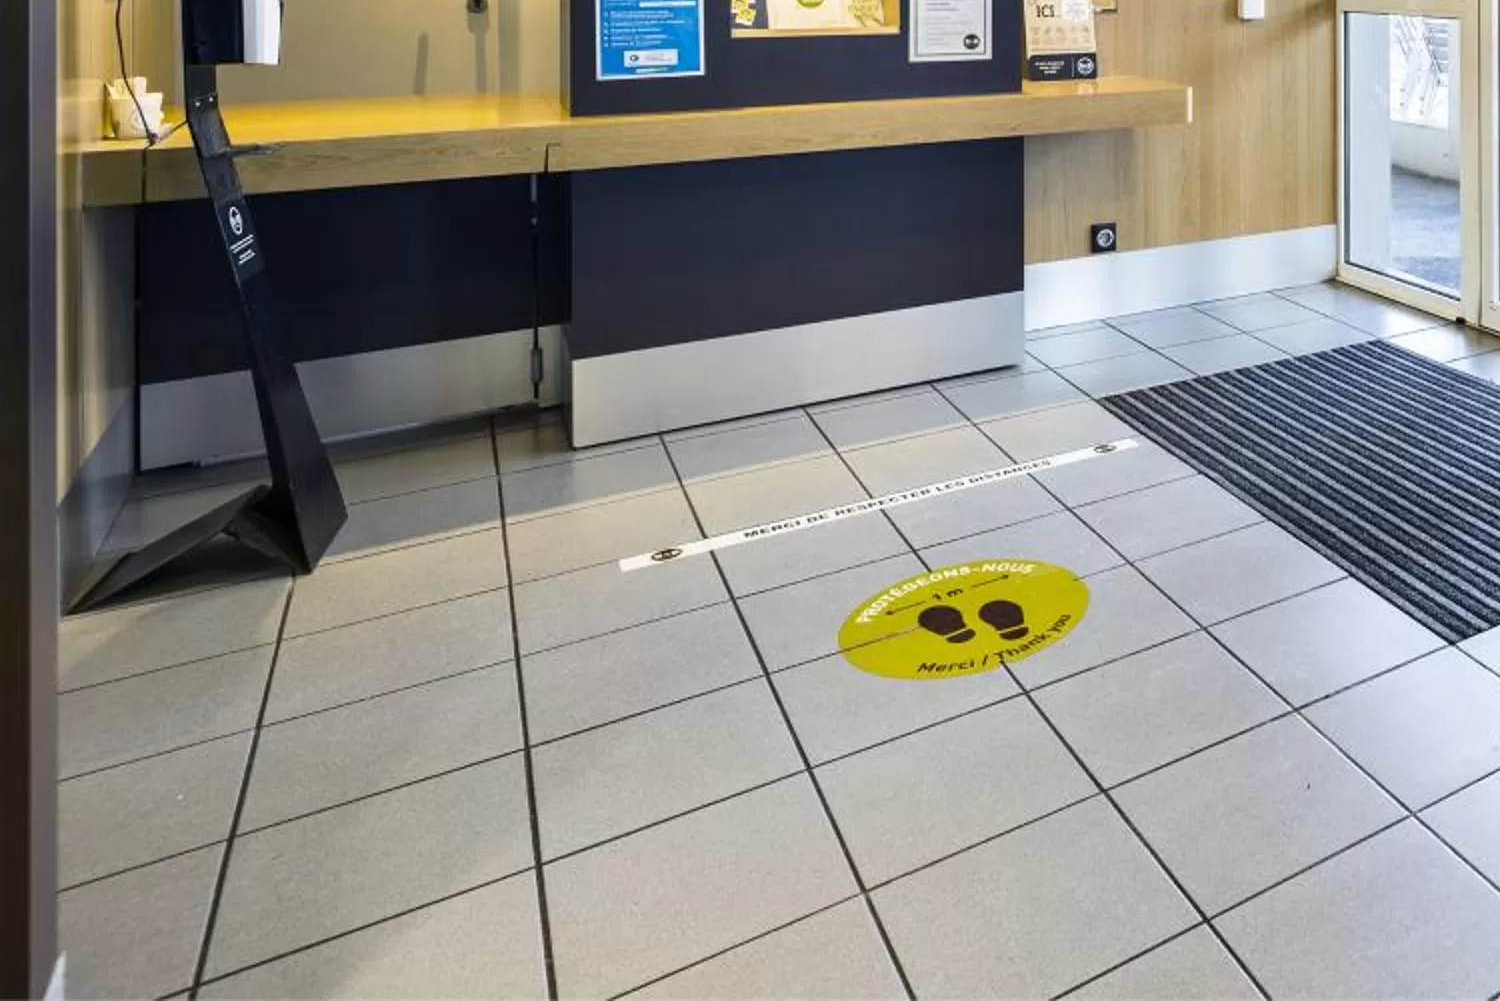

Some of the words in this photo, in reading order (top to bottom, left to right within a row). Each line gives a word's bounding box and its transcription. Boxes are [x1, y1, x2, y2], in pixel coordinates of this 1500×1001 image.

[743, 519, 801, 538] MERCI
[834, 488, 932, 517] RESPECTER
[968, 459, 1052, 484] DISTANCES
[916, 659, 976, 673] Merci
[992, 633, 1052, 663] Thank
[1047, 613, 1073, 639] you
